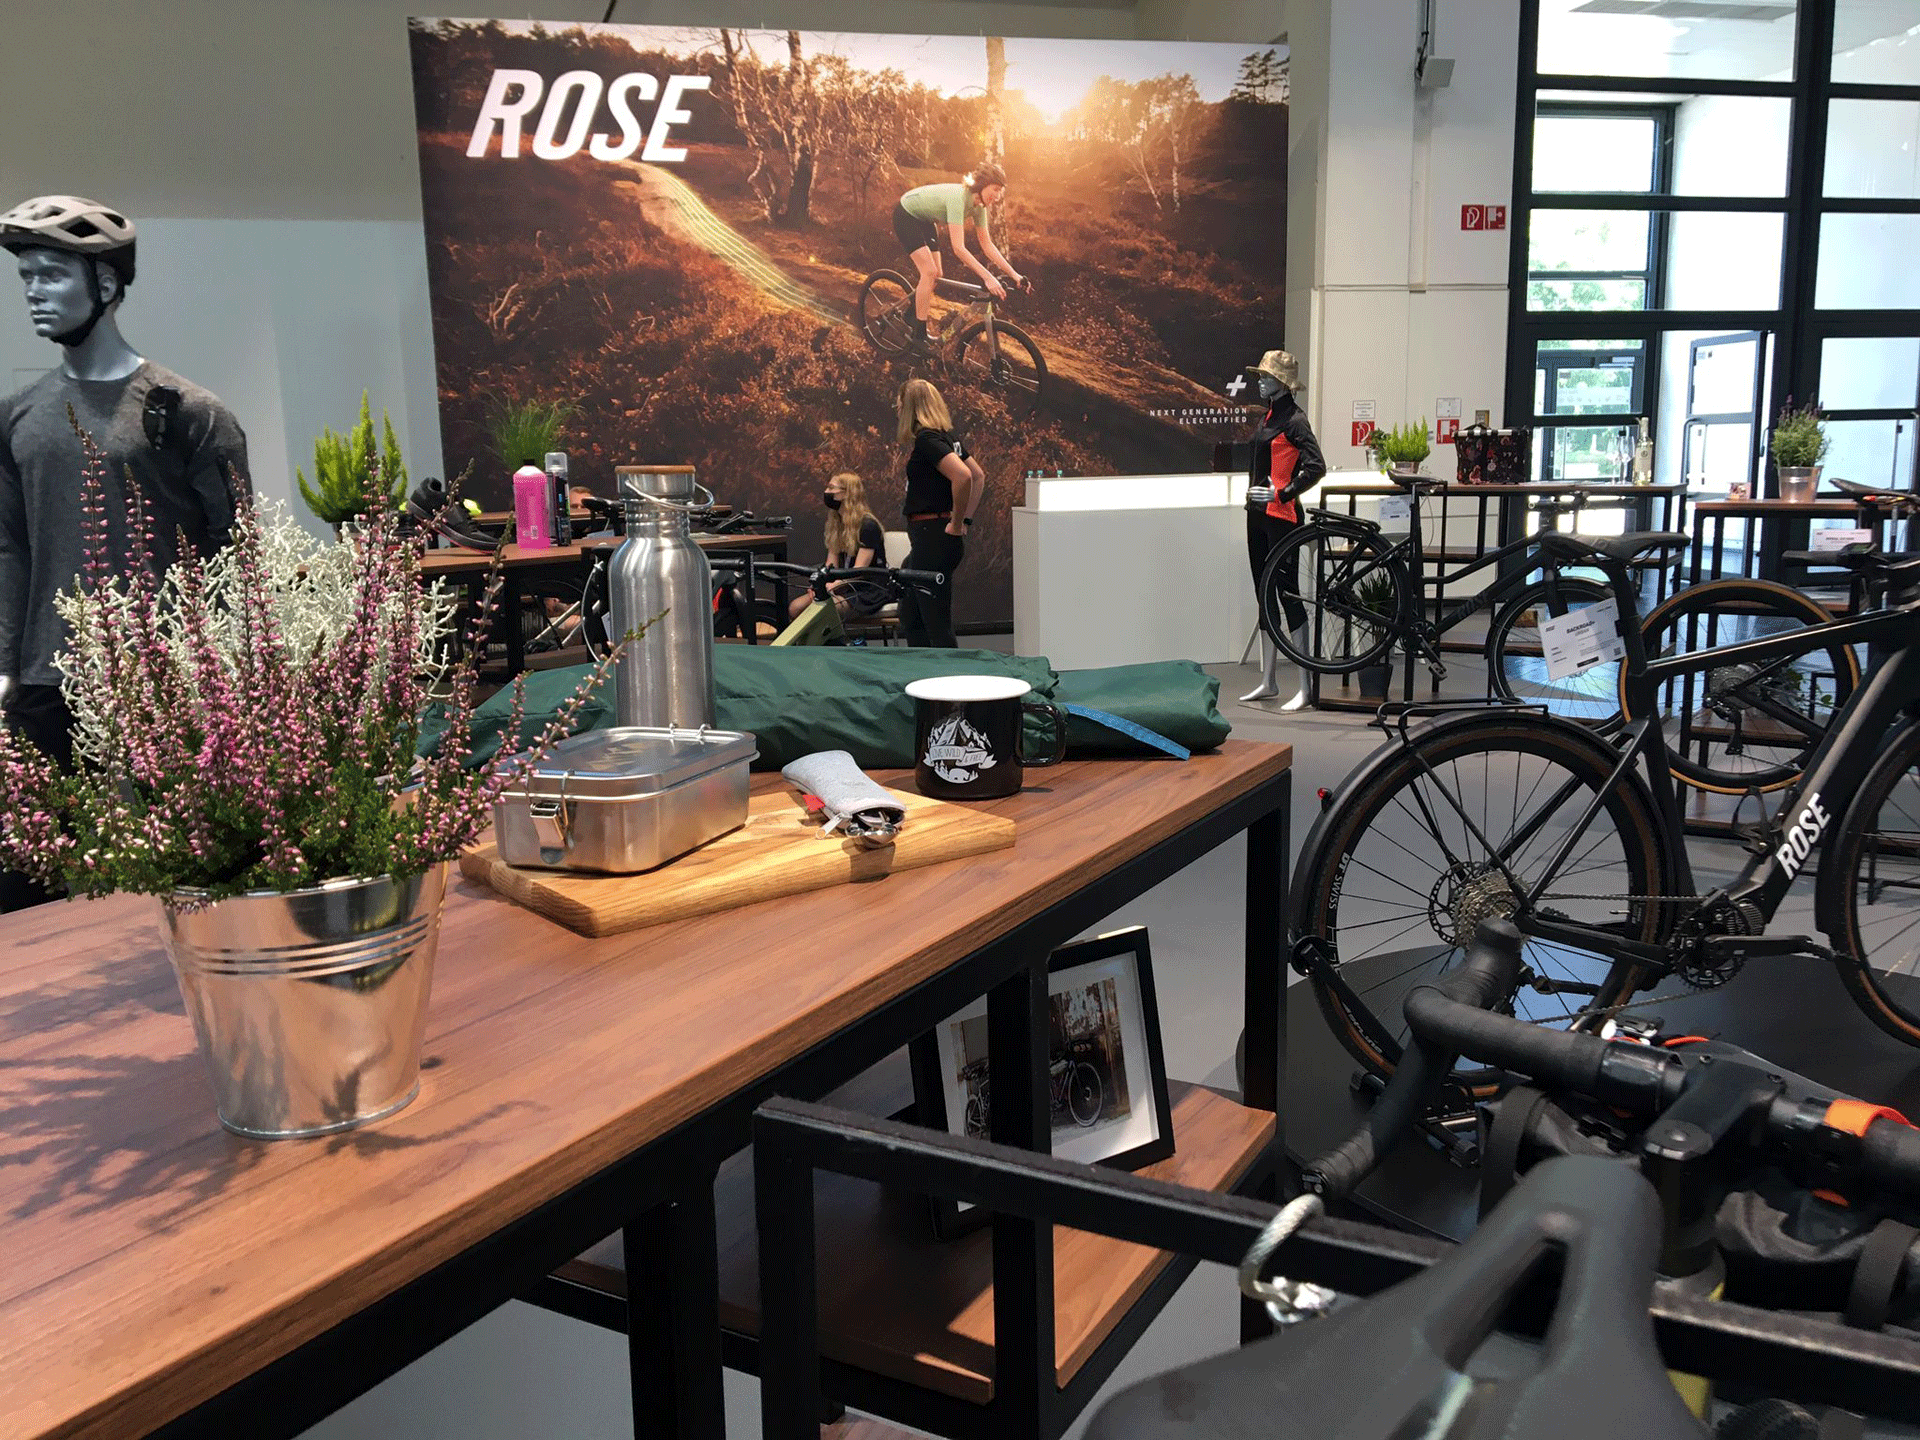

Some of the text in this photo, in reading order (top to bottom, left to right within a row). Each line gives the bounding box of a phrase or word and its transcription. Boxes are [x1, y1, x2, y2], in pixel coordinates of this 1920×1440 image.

[466, 69, 712, 162] ROSE
[1149, 407, 1247, 417] NEXT GENERATION
[1179, 416, 1247, 425] ELECTRIFIED
[1776, 792, 1831, 880] ROSE
[1338, 852, 1351, 871] DT
[1328, 875, 1343, 910] SWISS
